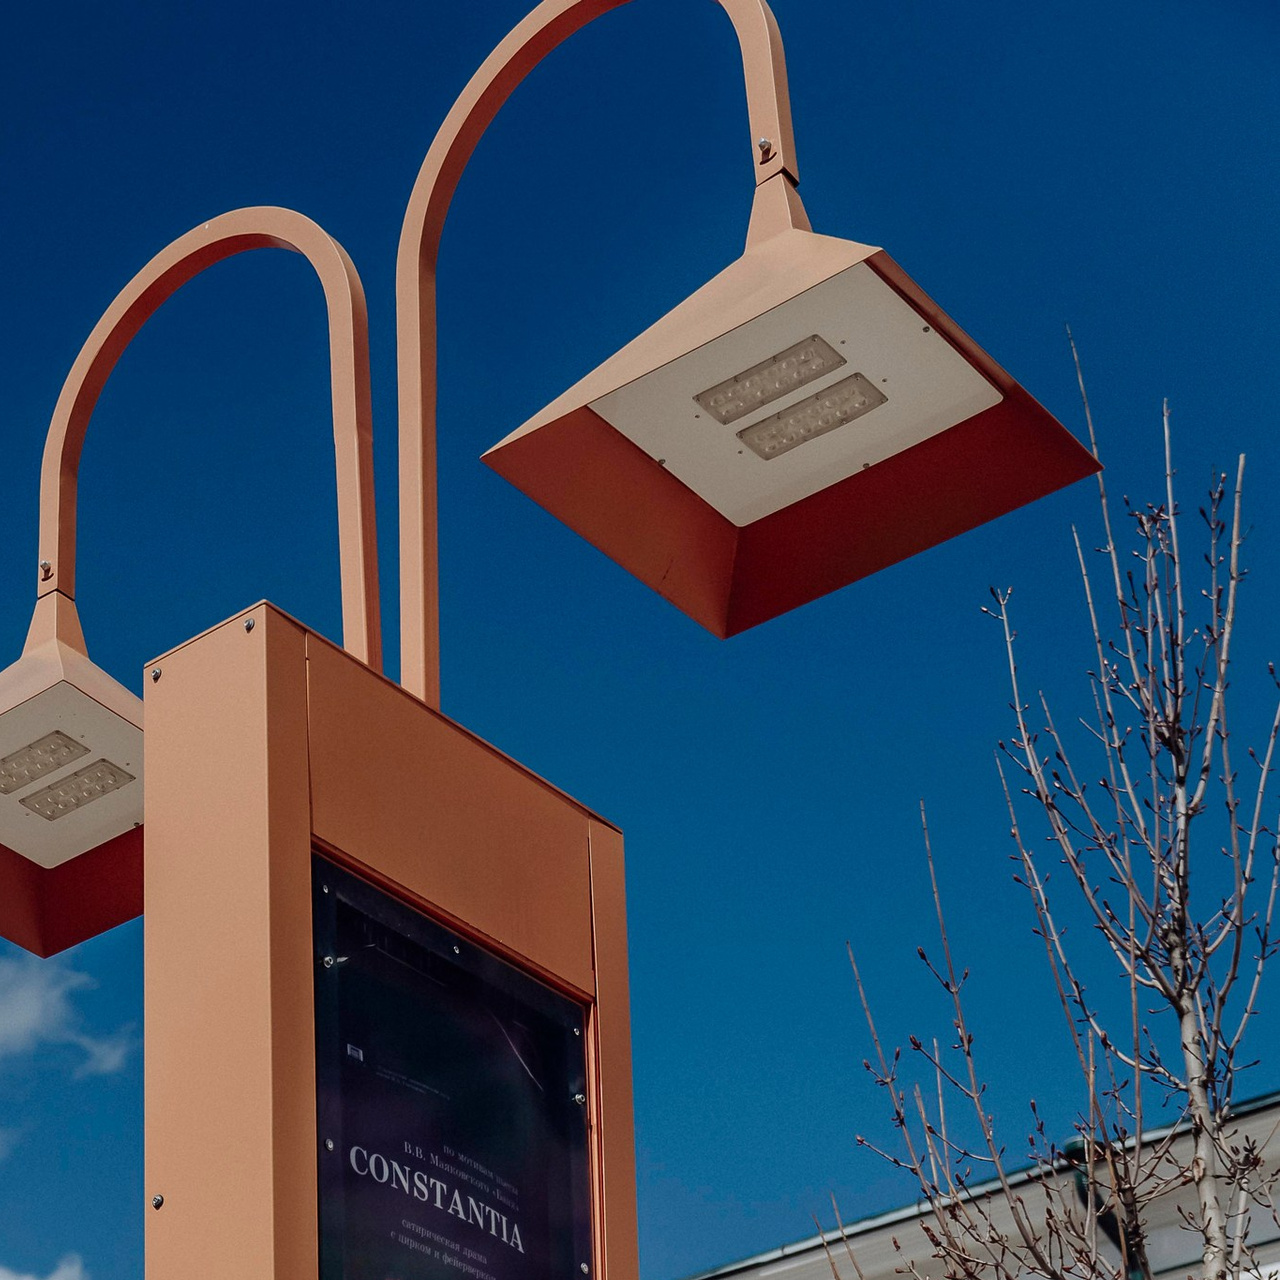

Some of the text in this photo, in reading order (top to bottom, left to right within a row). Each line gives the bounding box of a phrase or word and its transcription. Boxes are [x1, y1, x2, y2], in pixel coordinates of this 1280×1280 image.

[404, 1141, 426, 1161] В.В.
[430, 1152, 490, 1193] Маяковского
[443, 1145, 455, 1157] по
[458, 1152, 494, 1180] мотивам
[350, 1146, 525, 1254] CONSTANTIA
[398, 1234, 431, 1255] цирком
[401, 1219, 487, 1264] сатирическая драма
